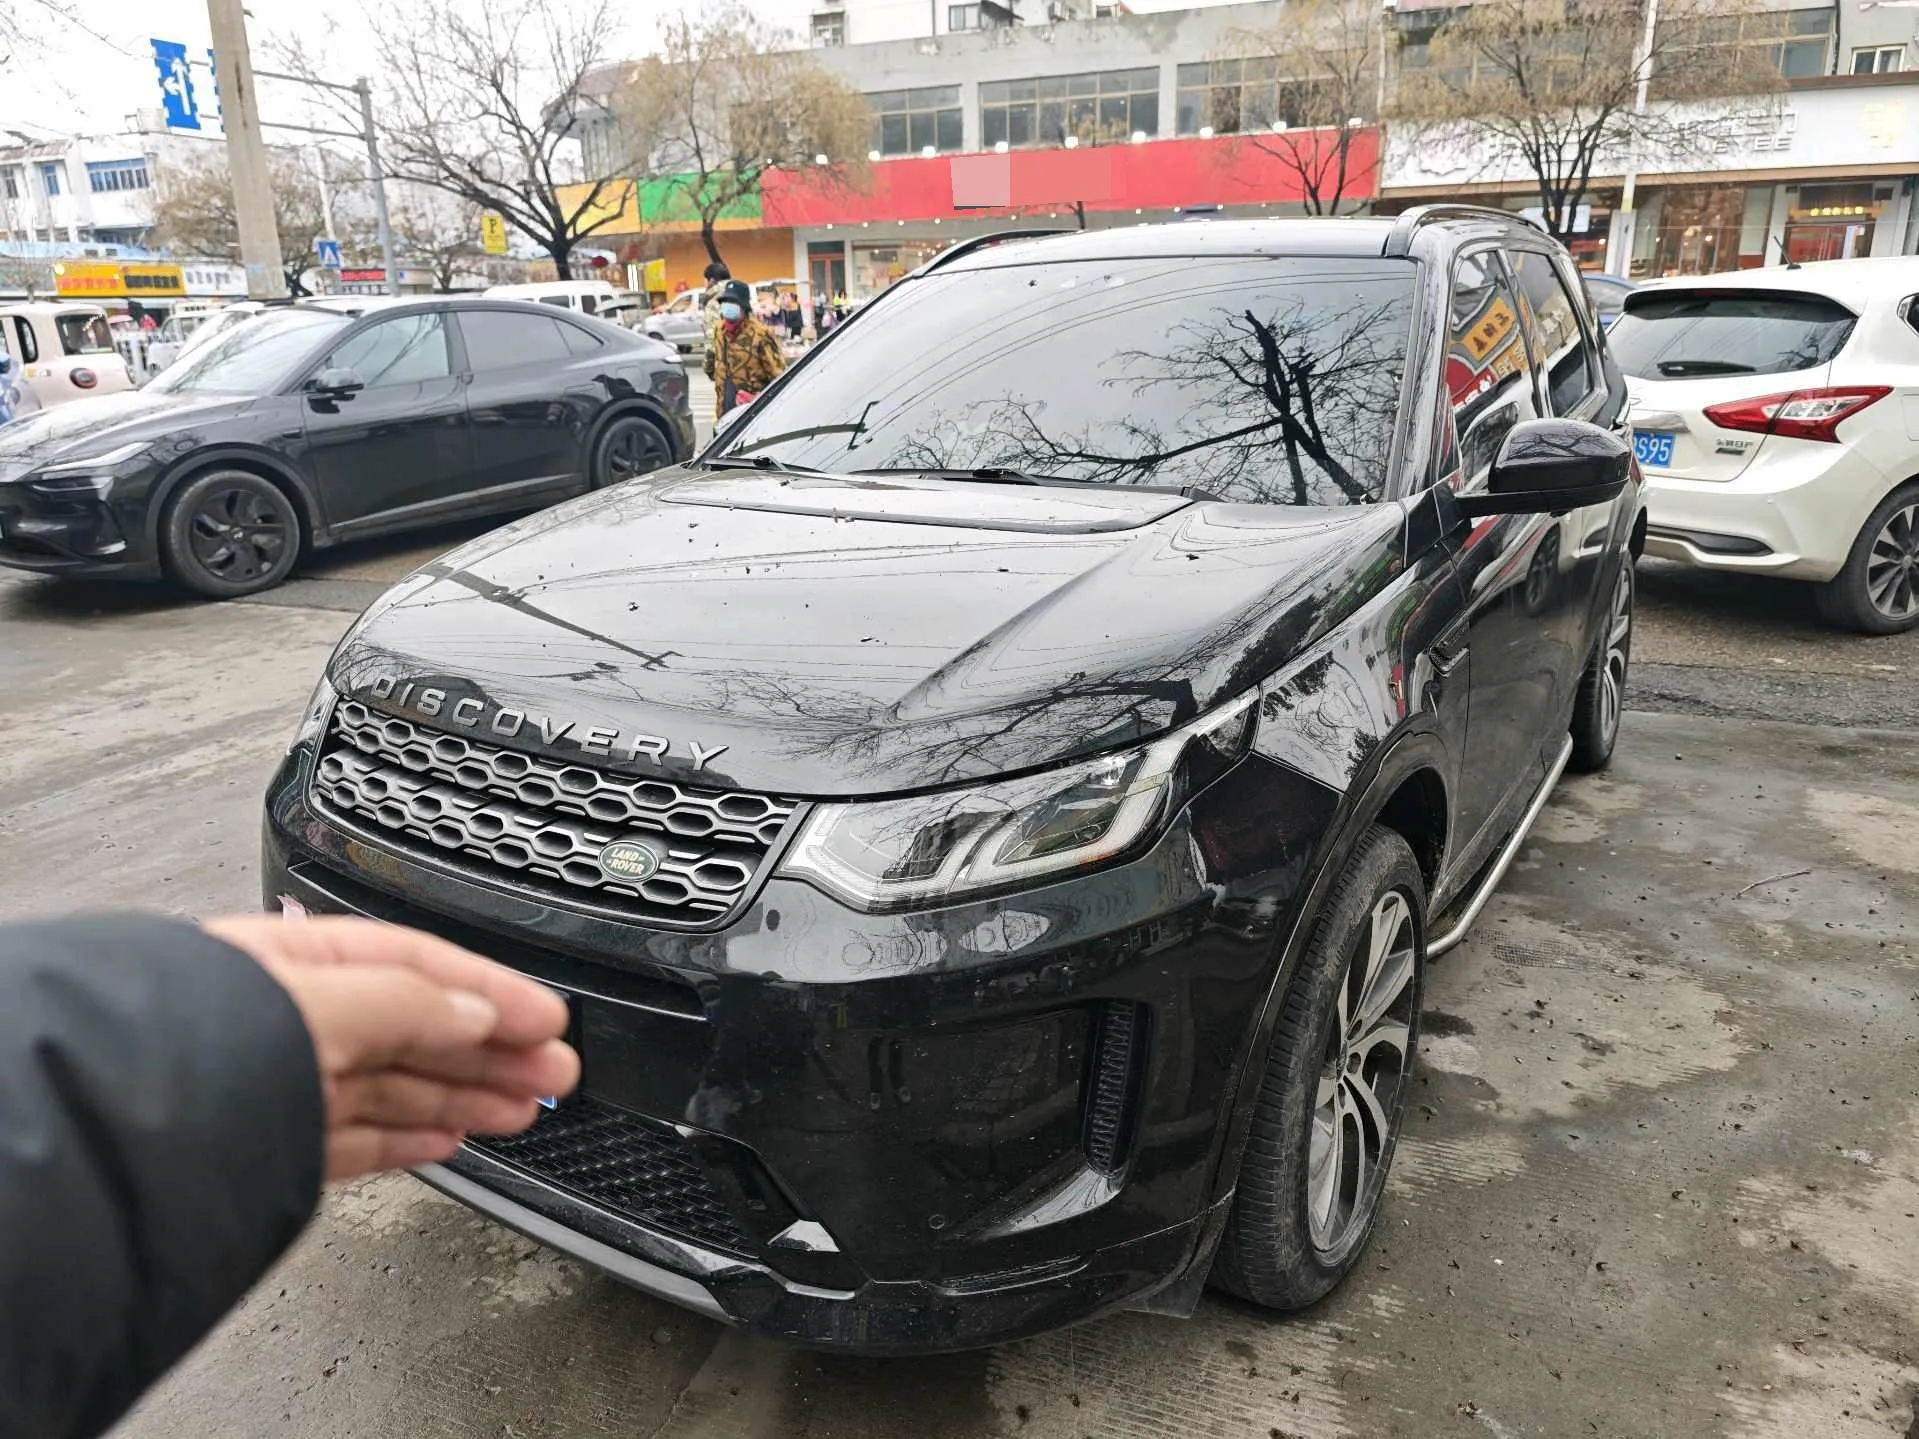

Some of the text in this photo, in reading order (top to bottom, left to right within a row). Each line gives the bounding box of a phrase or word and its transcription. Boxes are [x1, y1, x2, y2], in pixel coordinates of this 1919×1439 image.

[1633, 436, 1672, 462] S95
[369, 674, 730, 772] DISCOVERY
[610, 847, 640, 862] LAND
[610, 858, 645, 874] ROVER
